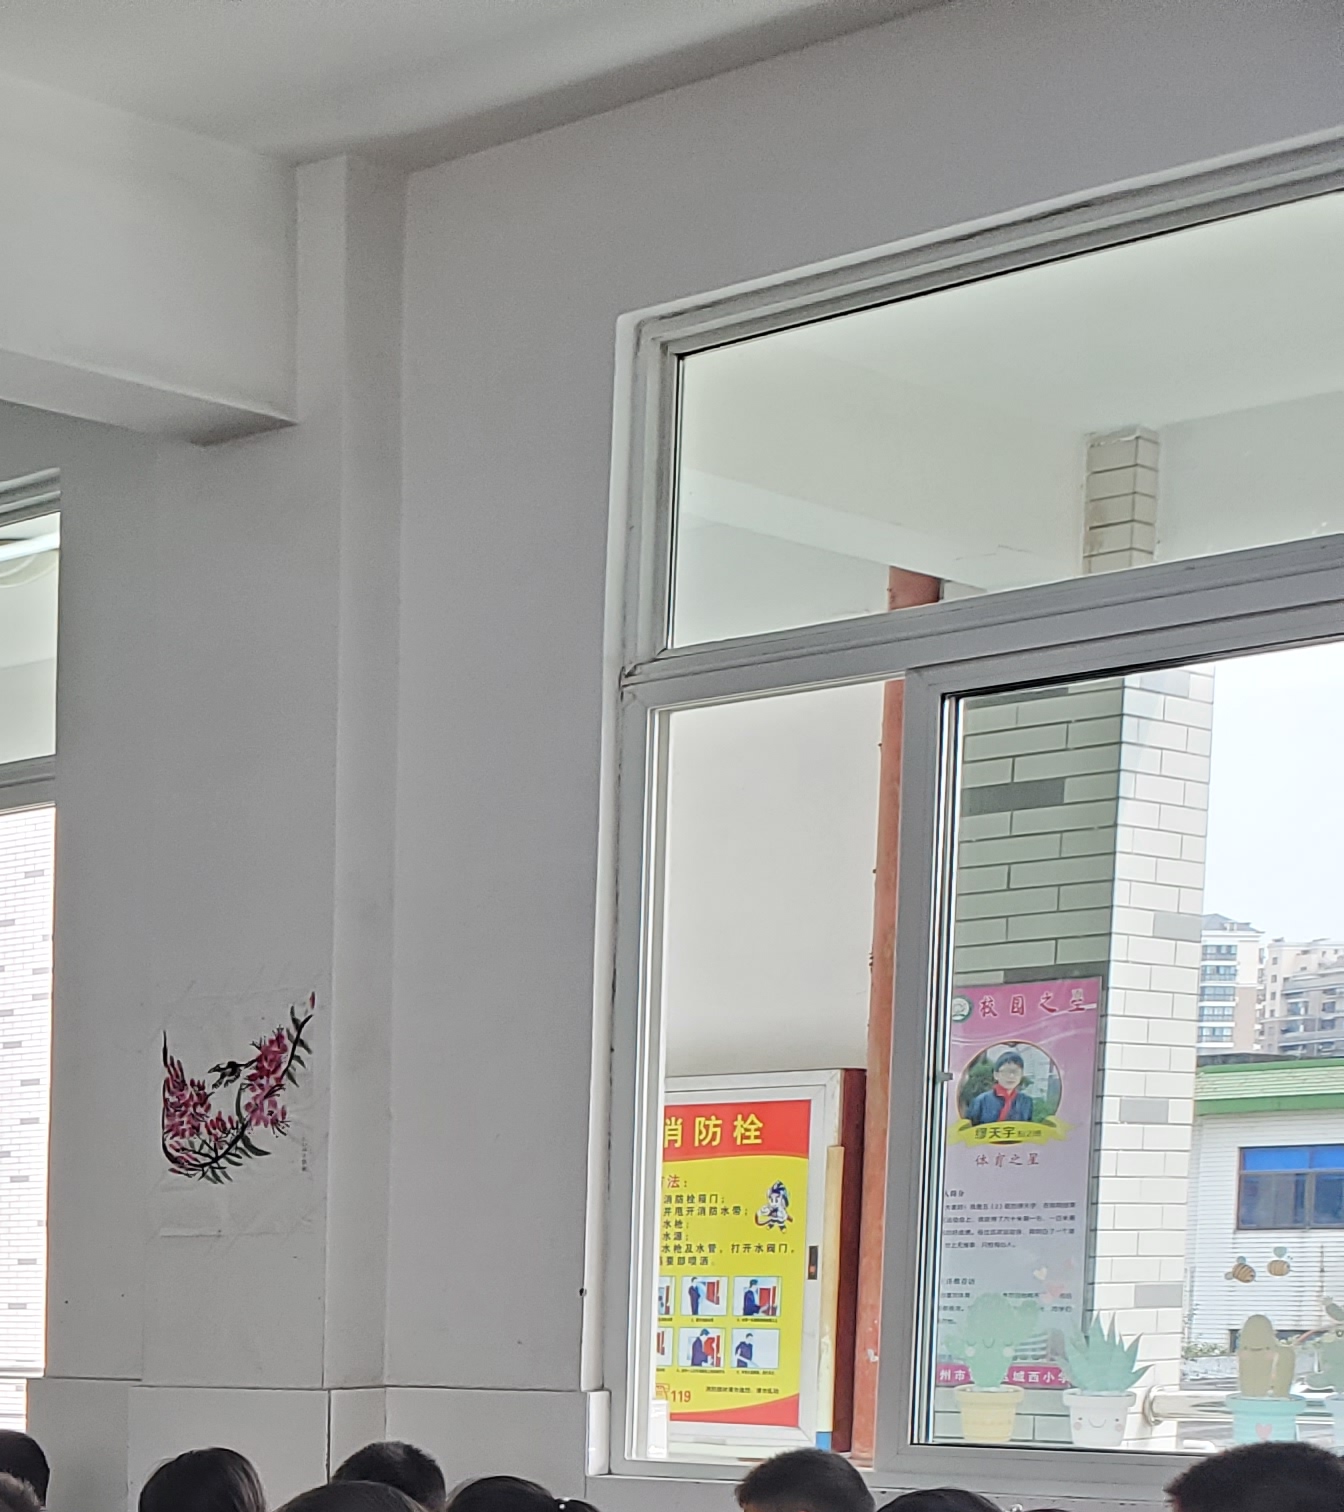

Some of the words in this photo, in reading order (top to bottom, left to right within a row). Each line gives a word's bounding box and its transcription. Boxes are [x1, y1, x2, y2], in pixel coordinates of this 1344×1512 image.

[979, 988, 1086, 1018] 校园之星
[975, 1152, 1040, 1166] 体育之星
[670, 1390, 691, 1403] 119
